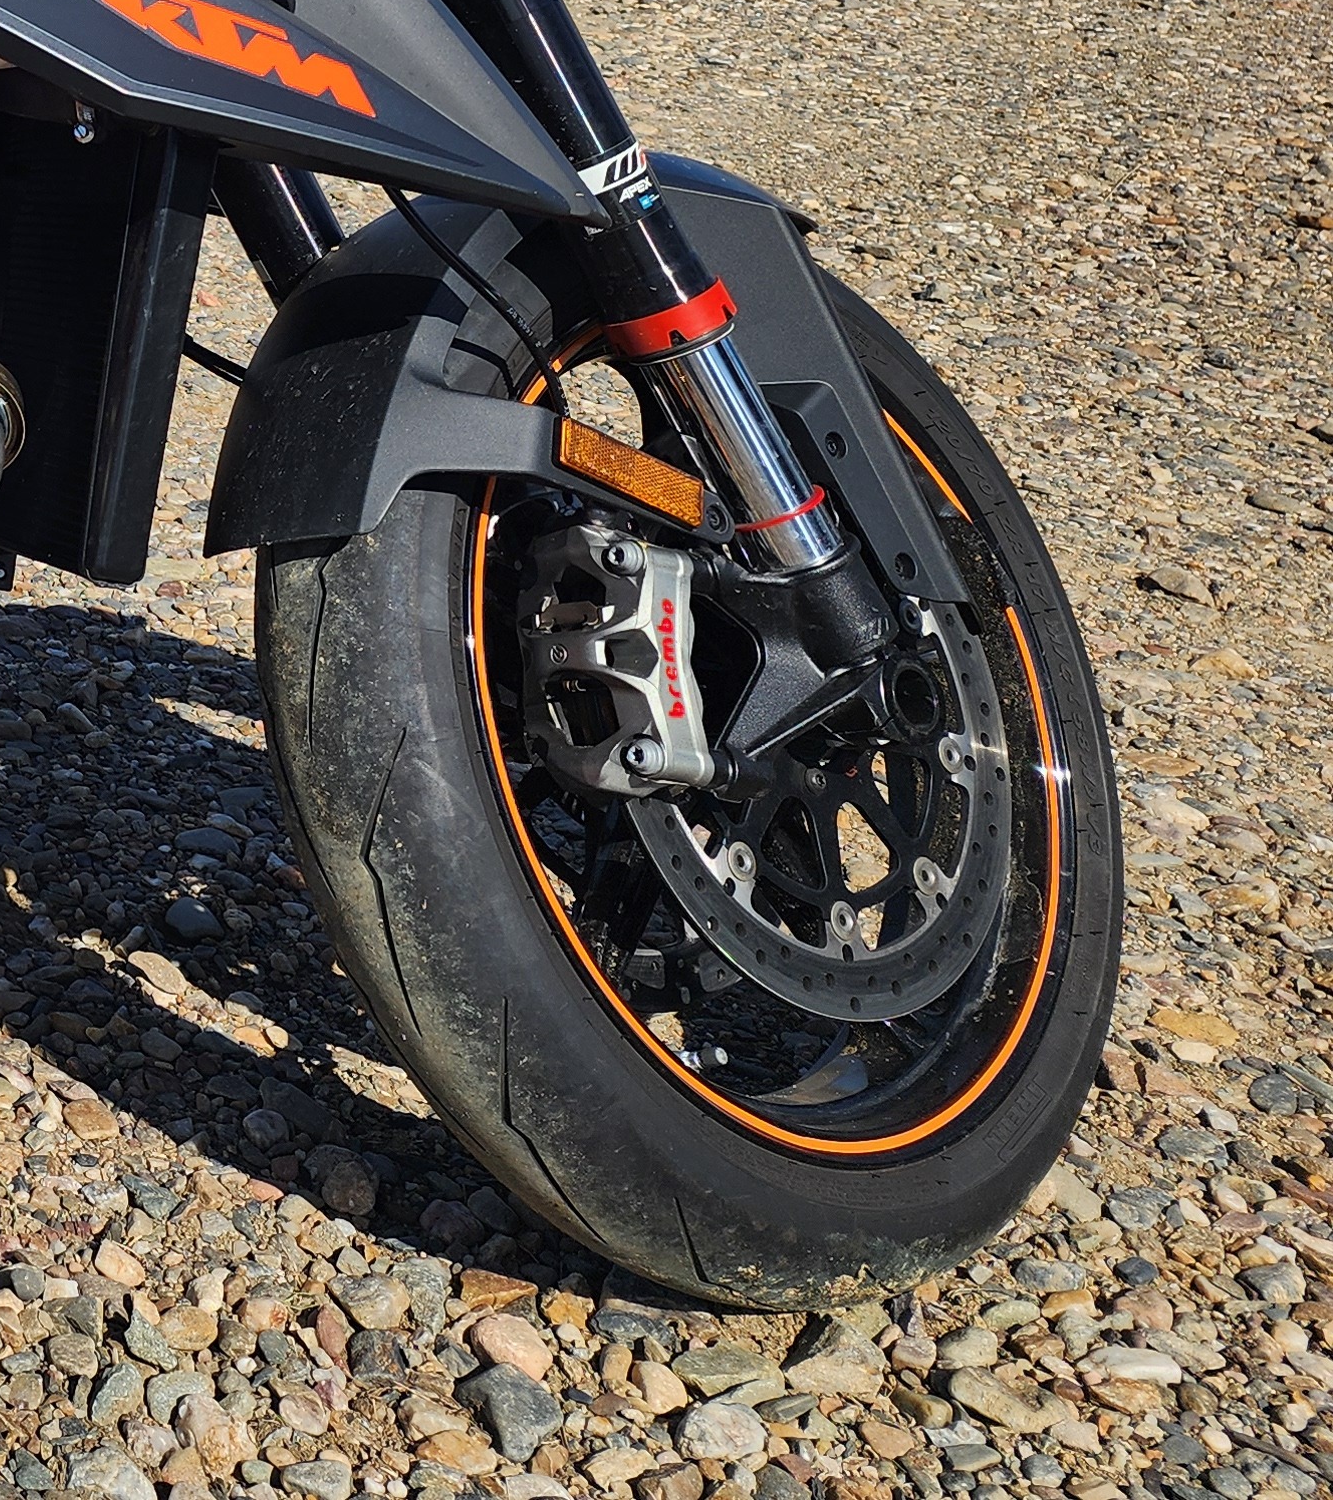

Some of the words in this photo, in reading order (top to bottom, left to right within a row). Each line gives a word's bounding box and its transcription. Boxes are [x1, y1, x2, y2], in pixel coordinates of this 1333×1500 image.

[619, 176, 652, 203] APEX
[657, 598, 685, 718] brembo
[982, 1073, 1052, 1162] PIRELLI
